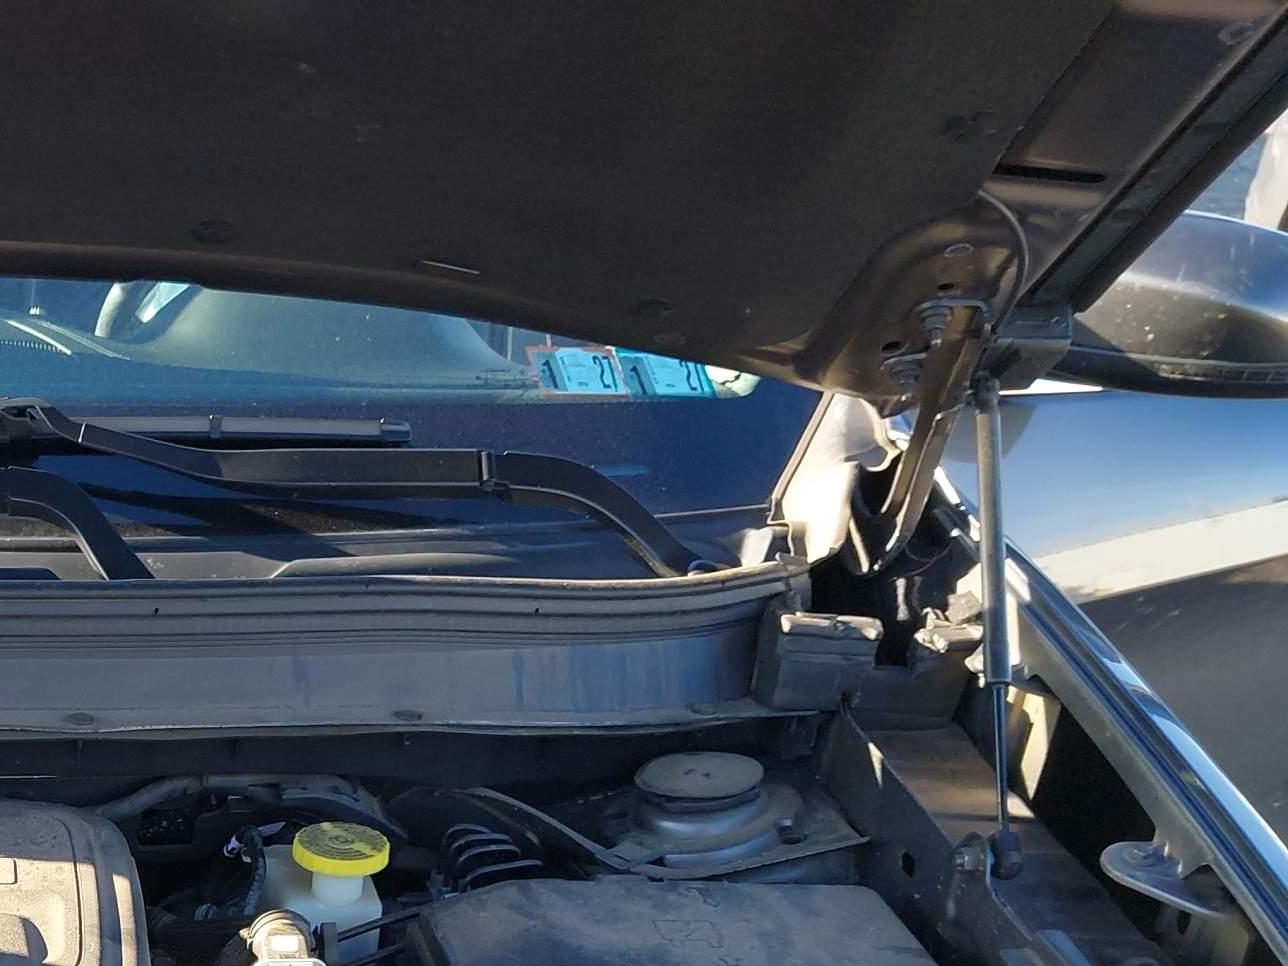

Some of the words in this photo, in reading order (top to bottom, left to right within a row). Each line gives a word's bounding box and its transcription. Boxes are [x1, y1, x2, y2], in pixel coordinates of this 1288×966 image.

[541, 359, 559, 389] 1
[592, 355, 618, 392] 27
[630, 365, 648, 395] 1
